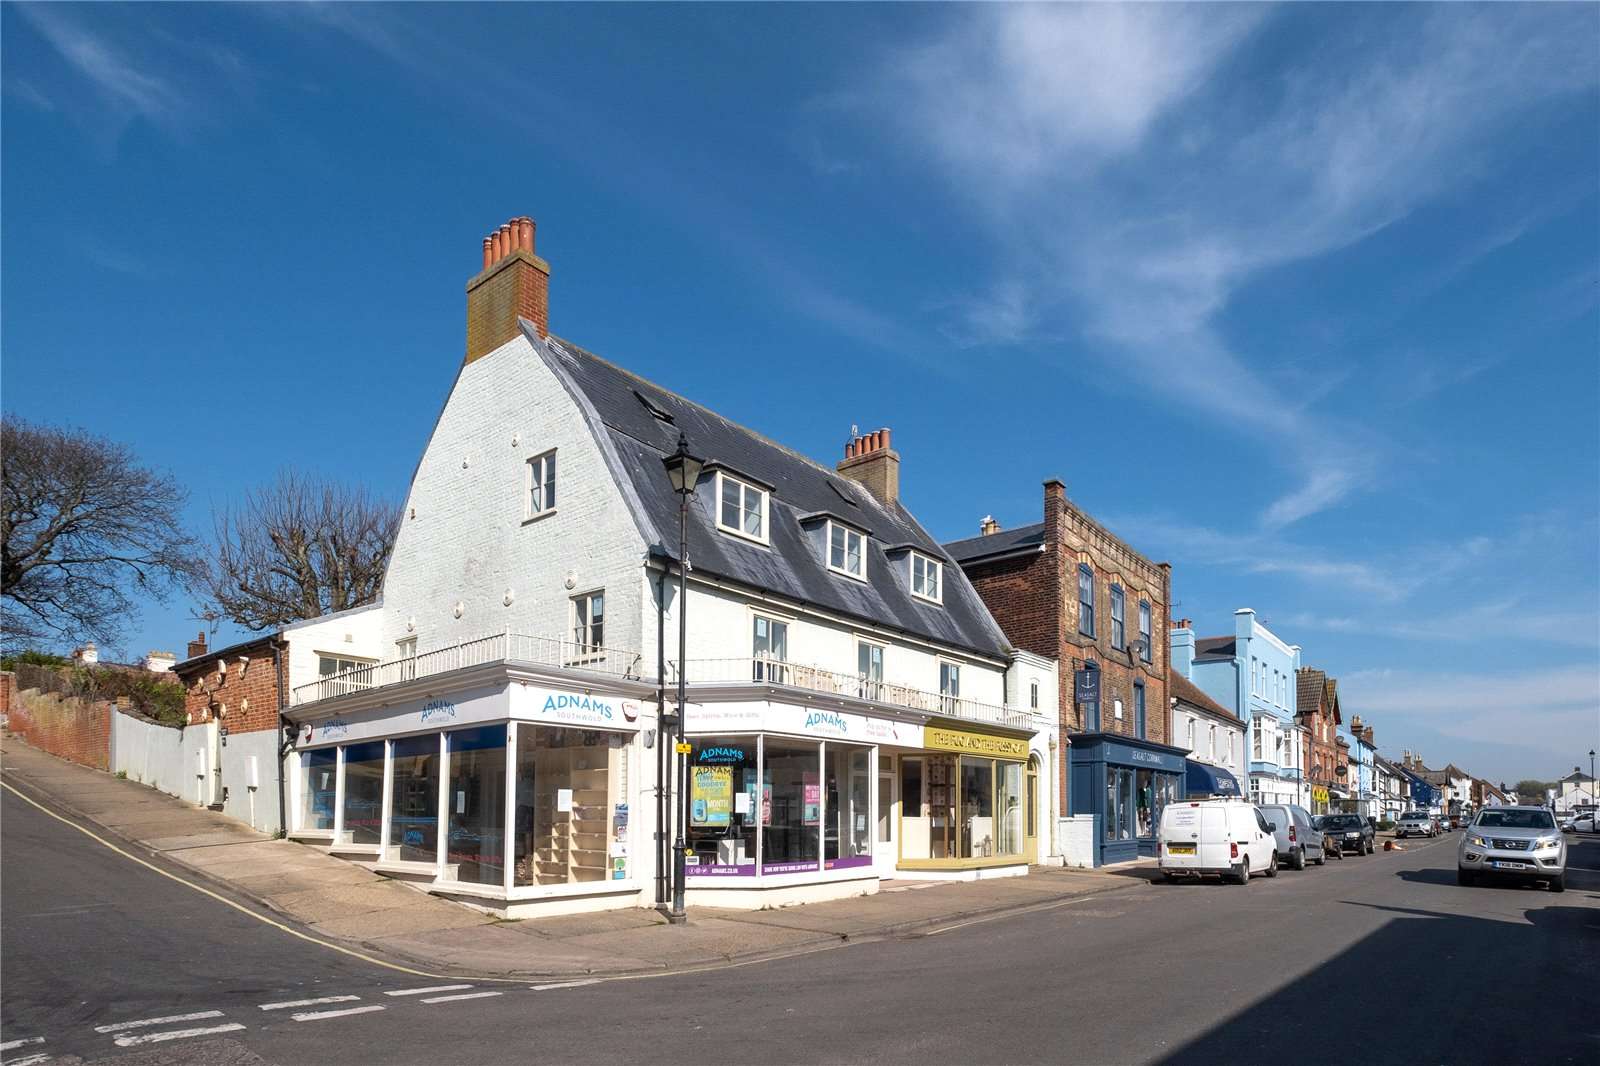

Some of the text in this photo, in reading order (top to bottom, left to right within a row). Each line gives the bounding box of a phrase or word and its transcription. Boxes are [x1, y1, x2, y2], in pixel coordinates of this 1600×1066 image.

[420, 701, 455, 721] ADNAMS
[542, 695, 612, 719] ADNAMS
[556, 712, 602, 721] SOUTHWOLD
[805, 712, 847, 732] ADNAMS
[322, 720, 347, 736] ADNAMS
[934, 732, 949, 745] THE
[700, 747, 743, 760] ADNAMS
